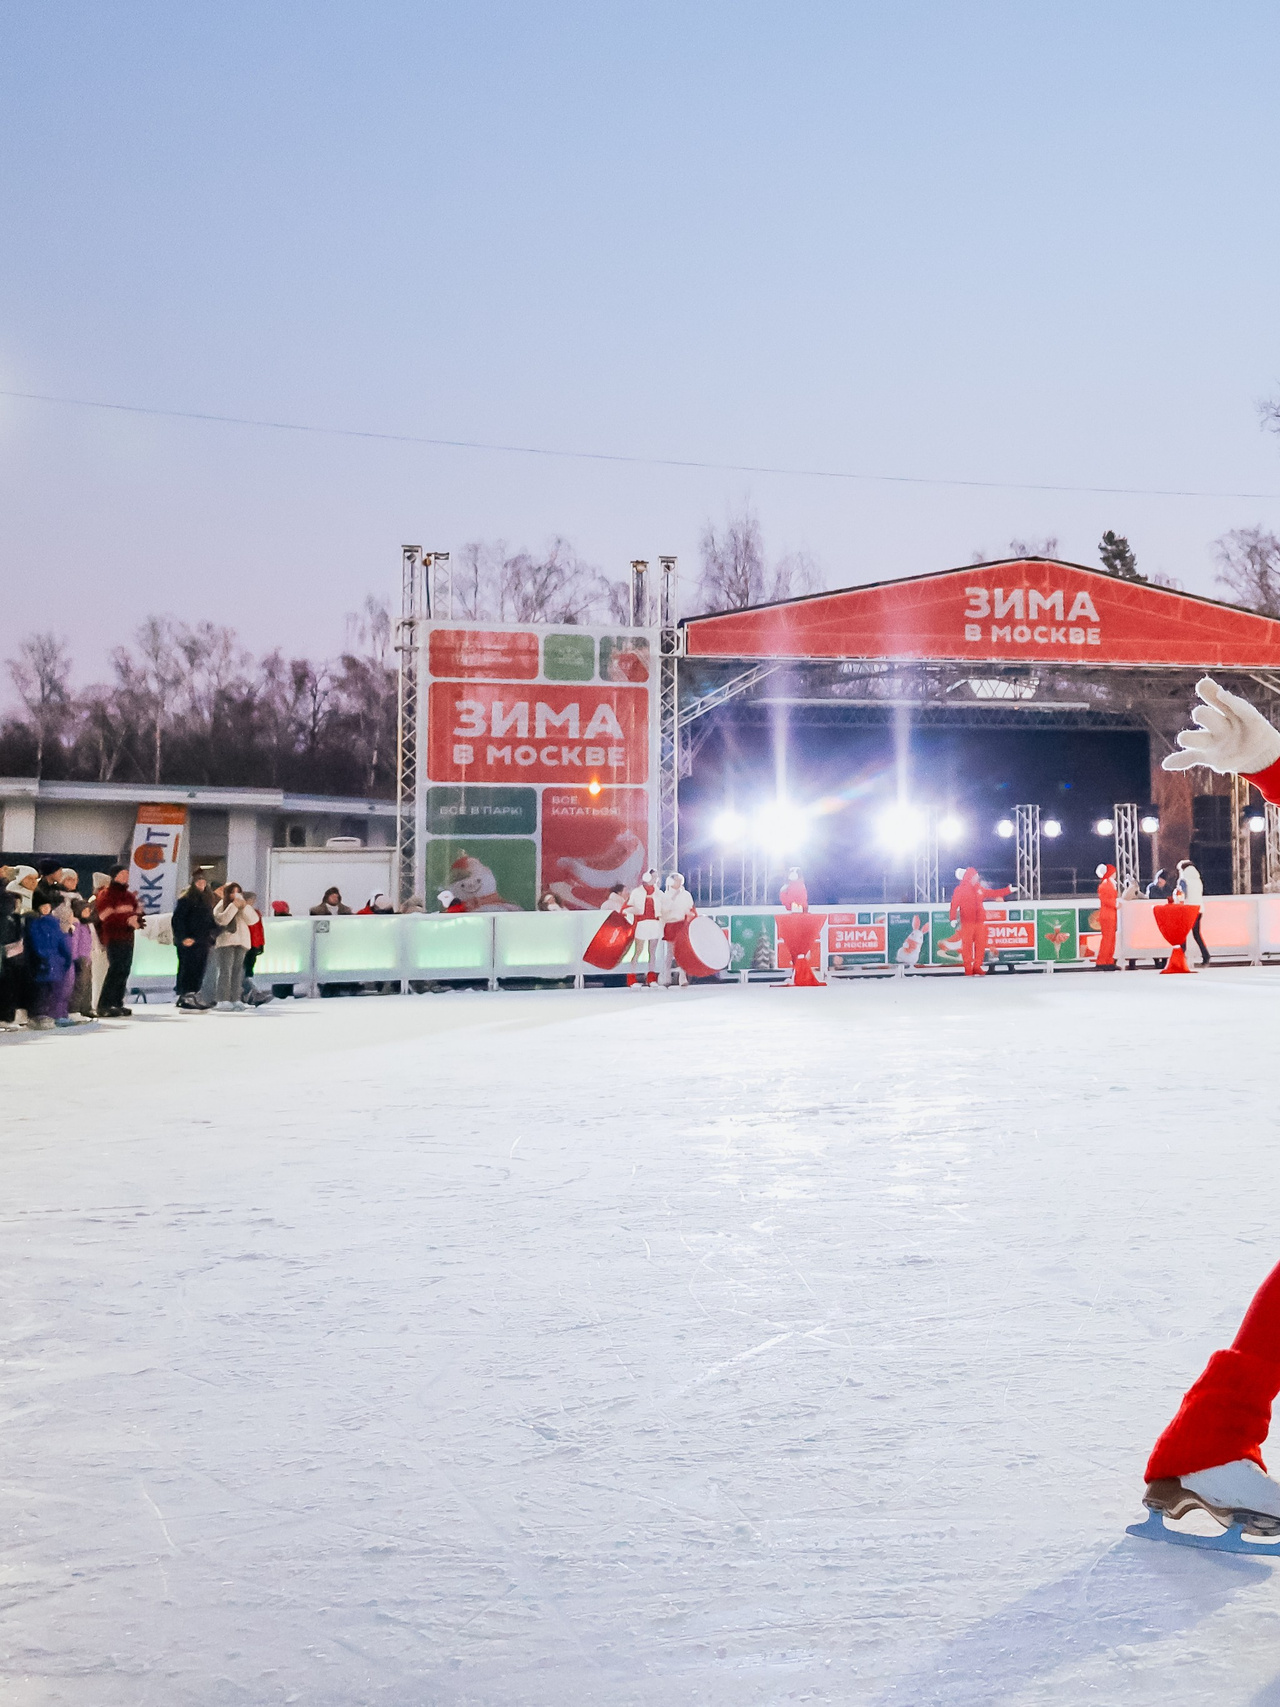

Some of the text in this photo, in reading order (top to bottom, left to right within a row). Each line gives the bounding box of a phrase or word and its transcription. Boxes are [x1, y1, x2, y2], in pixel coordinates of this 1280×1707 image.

[964, 587, 1100, 622] ЗИМА
[965, 624, 1101, 645] В МОСКВЕ
[453, 700, 624, 739] ЗИМА
[453, 744, 625, 767] В МОСКВЕ
[835, 930, 878, 941] ЗИМА
[987, 926, 1028, 938] ЗИМА
